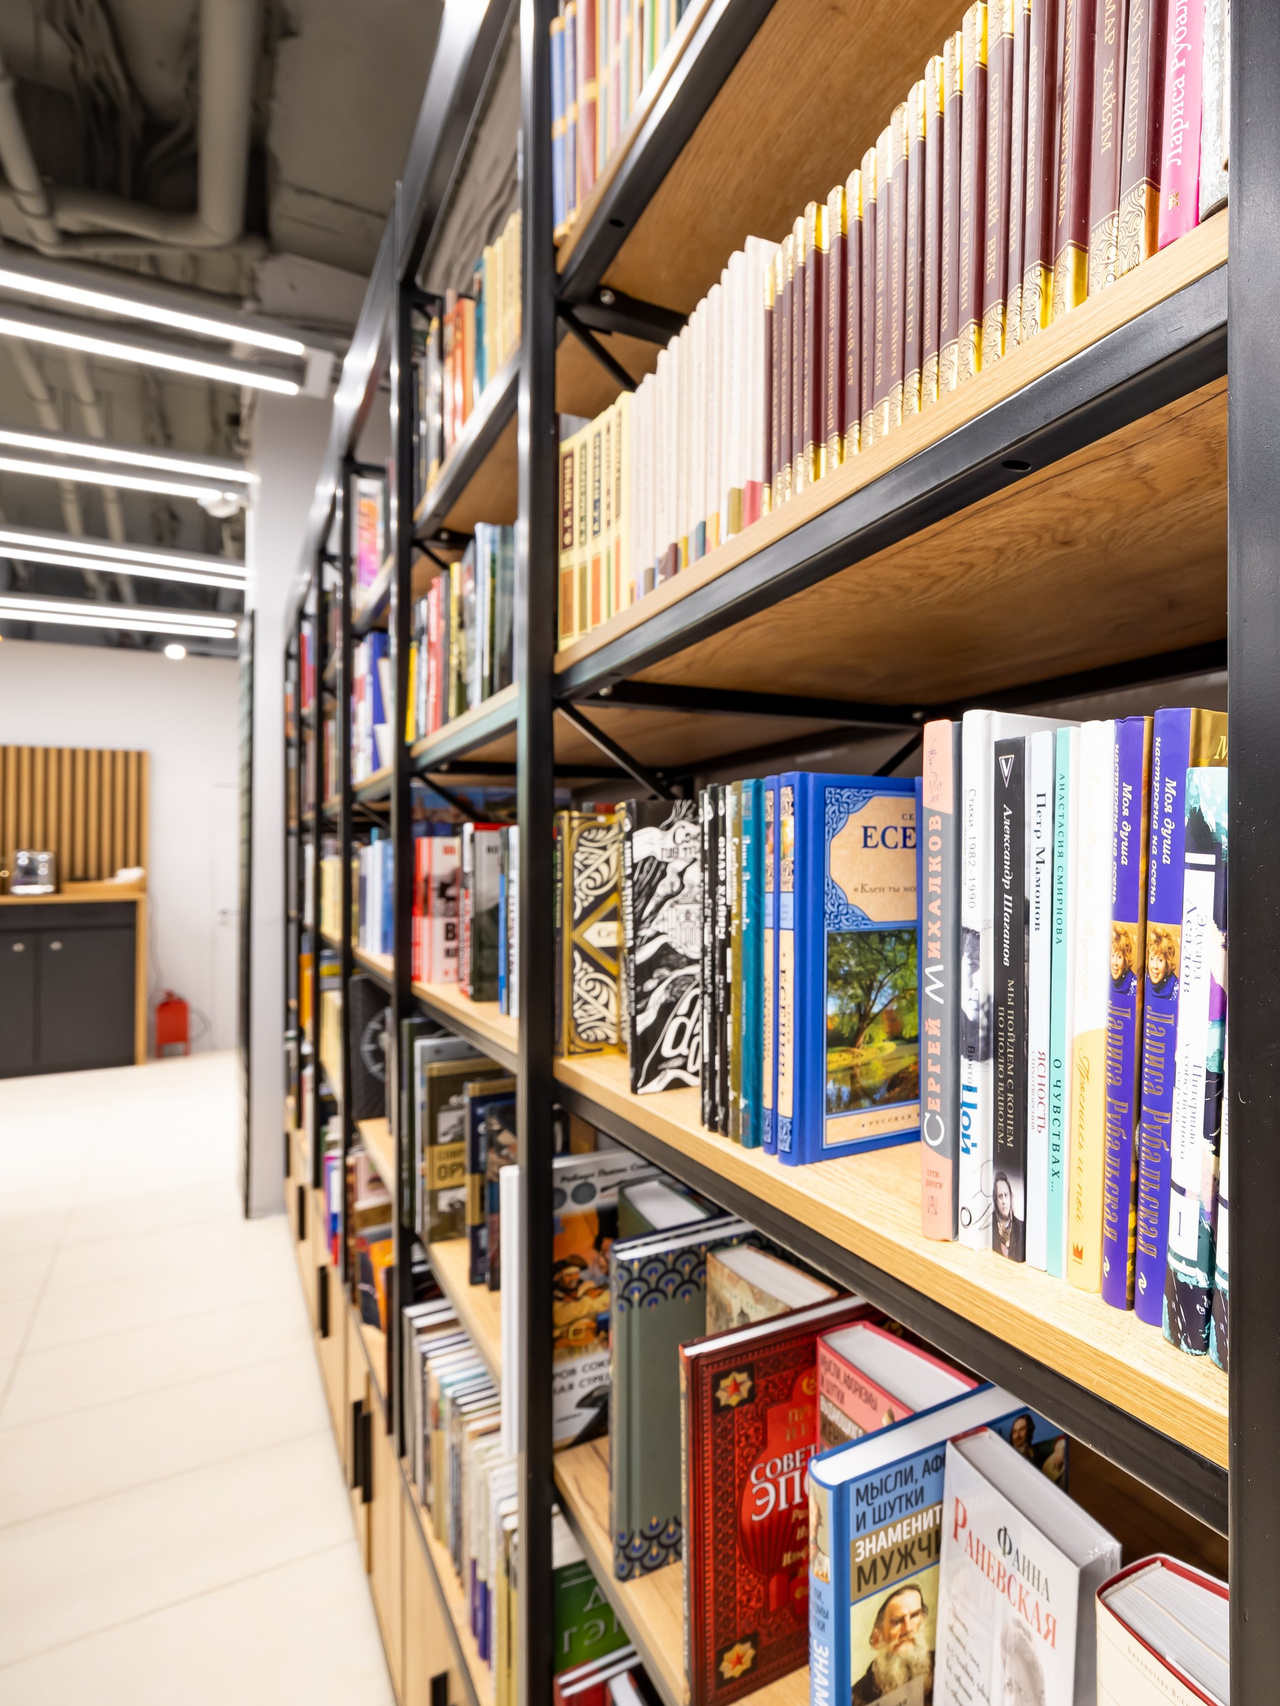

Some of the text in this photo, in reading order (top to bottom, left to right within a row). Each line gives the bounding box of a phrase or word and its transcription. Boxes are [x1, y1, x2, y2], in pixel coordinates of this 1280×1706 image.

[1026, 44, 1039, 215] ФЕДОР ТЮТЧЕВ
[1099, 58, 1117, 156] ХАЙЯМ
[1125, 35, 1144, 162] ГУМИЛЕВ
[1167, 74, 1189, 168] Лариса
[960, 91, 972, 312] АЛЕКСАНДР ПУШКИН
[986, 72, 1000, 284] СЕРЕБРЯНЫЙ ВЕК
[1009, 63, 1021, 251] СТИХИ О РОССИИ
[1058, 96, 1071, 227] ЦВЕТАЕВА
[875, 209, 885, 386] НИКОЛАЙ НЕКРАСОВ
[907, 245, 915, 310] АЛЛАН
[941, 209, 950, 332] ЛЕРМОНТОВ
[891, 310, 899, 377] БАЙРОН
[906, 314, 914, 343] ПО
[826, 330, 835, 431] МАЯКОВСКИЙ
[717, 836, 727, 882] ОМАР
[967, 788, 977, 827] Стихи
[1054, 772, 1066, 946] АНАСТАСИЯ СМИРНОВА
[1119, 782, 1133, 866] Моя душа
[1149, 736, 1162, 905] настроена на осень
[1161, 776, 1177, 865] Моя душа
[924, 814, 945, 1005] МИХАЛКОВ
[1001, 803, 1014, 967] Александр Шаганов
[1034, 791, 1047, 932] Петр Мамонов
[1182, 897, 1198, 994] Асадов
[1193, 914, 1208, 981] Эдуард
[778, 967, 787, 1079] ЕСЕНИН
[1005, 978, 1015, 1149] МЫ ПОЙДЕМ С КОНЕМ
[868, 1112, 913, 1128] РУССКАЯ
[924, 1018, 945, 1147] СЕРГЕЙ
[960, 1083, 979, 1156] Цой
[996, 1005, 1005, 1154] ПО ПОЛЮ ВДВОЕМ...
[1036, 1049, 1047, 1135] ЯСНОСТЬ
[1050, 1058, 1063, 1193] О ЧУВСТВАХ...
[1075, 1047, 1091, 1150] Проснись
[1103, 999, 1132, 1243] Лариса Рубальская
[1180, 1054, 1190, 1160] собственного
[1187, 1064, 1203, 1146] Интервью
[1138, 1005, 1175, 1258] Лариса Рубальская
[1075, 1184, 1087, 1225] пой
[1176, 1210, 1183, 1238] 1
[854, 1503, 944, 1563] ЗНАМЕНИТ
[855, 1464, 919, 1508] МЫСЛИ,
[855, 1485, 925, 1532] И ШУТКИ
[952, 1496, 1057, 1651] РАНЕВСКАЯ
[996, 1524, 1051, 1604] ФАИНА
